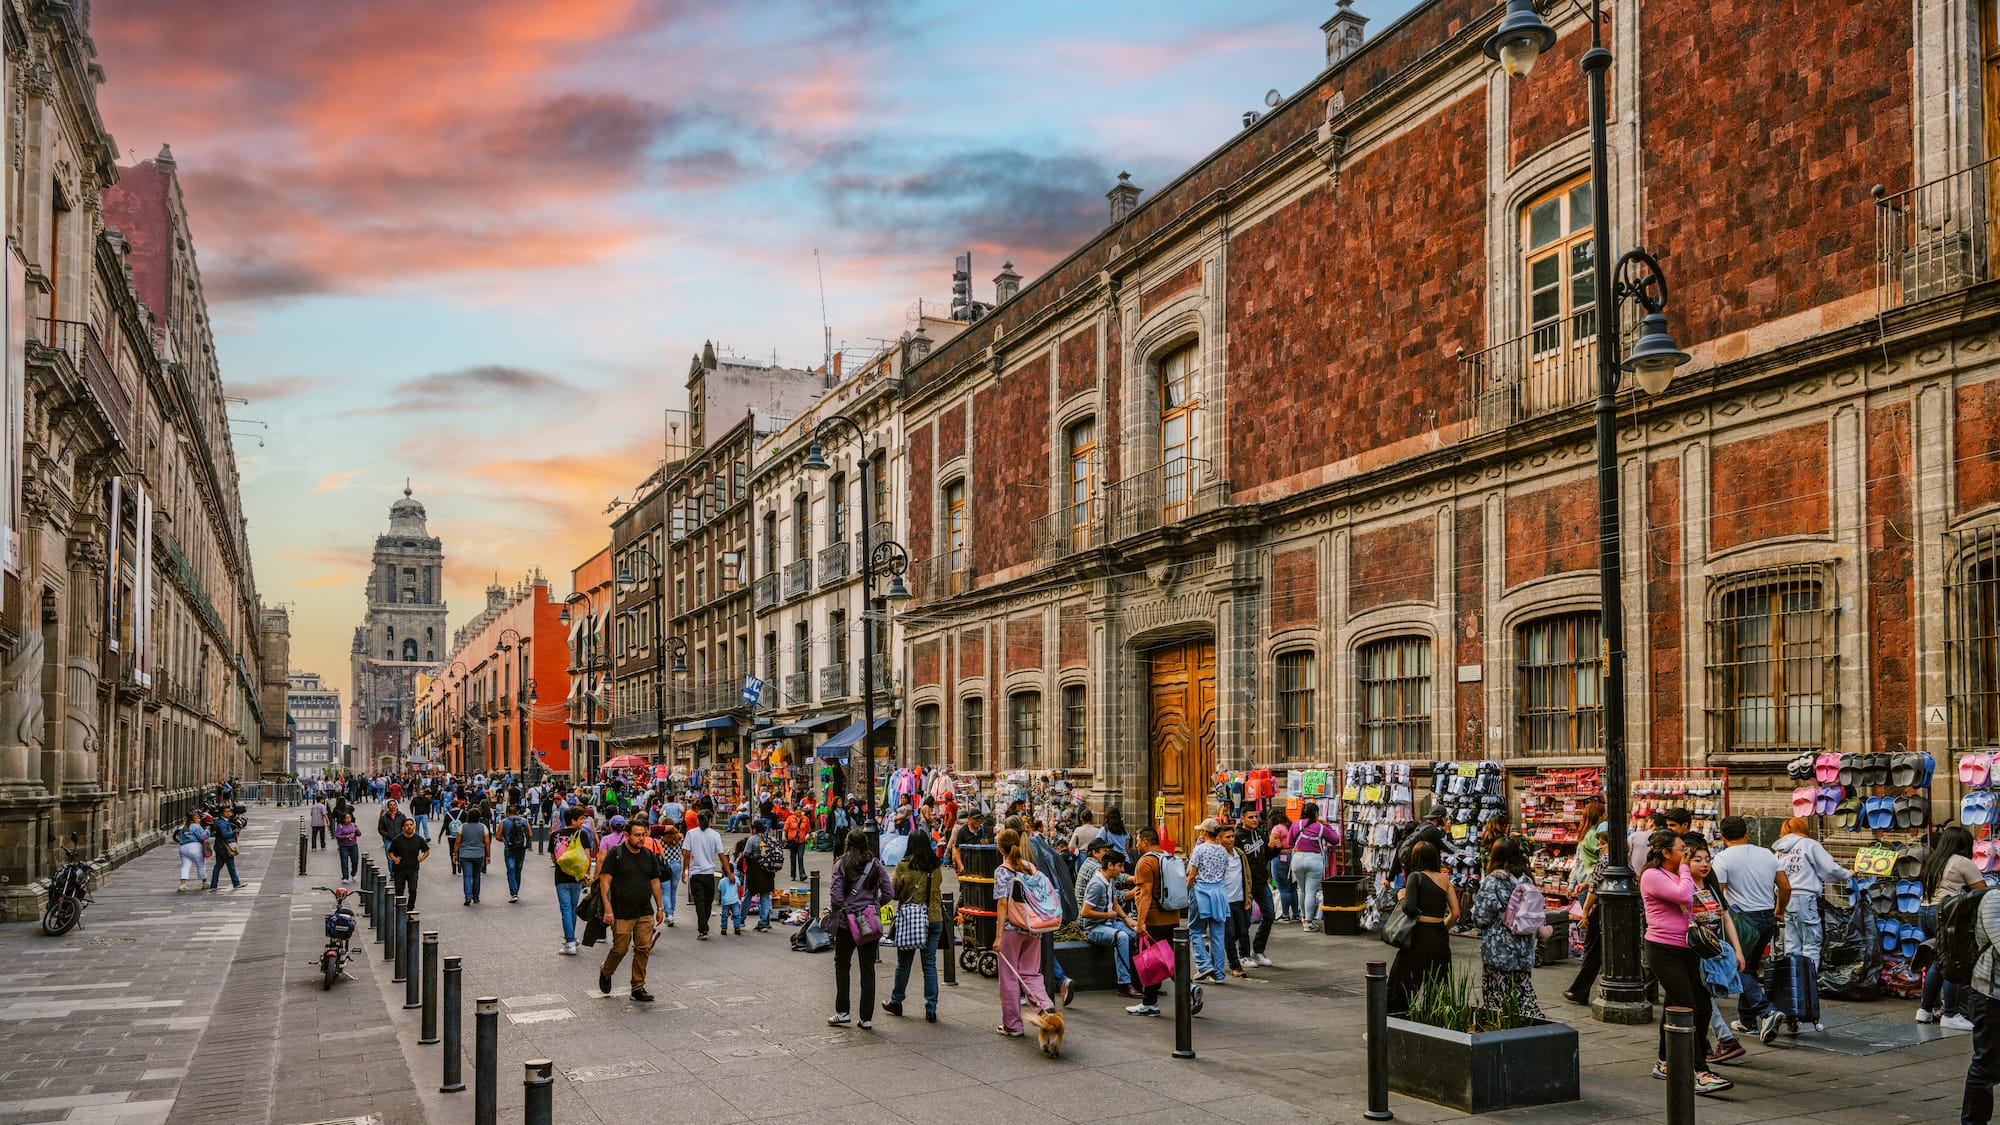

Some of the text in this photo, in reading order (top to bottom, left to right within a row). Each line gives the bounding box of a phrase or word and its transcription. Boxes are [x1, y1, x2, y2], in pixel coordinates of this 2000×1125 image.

[745, 674, 763, 693] WC
[1930, 708, 1944, 721] A
[1858, 855, 1891, 872] 50
